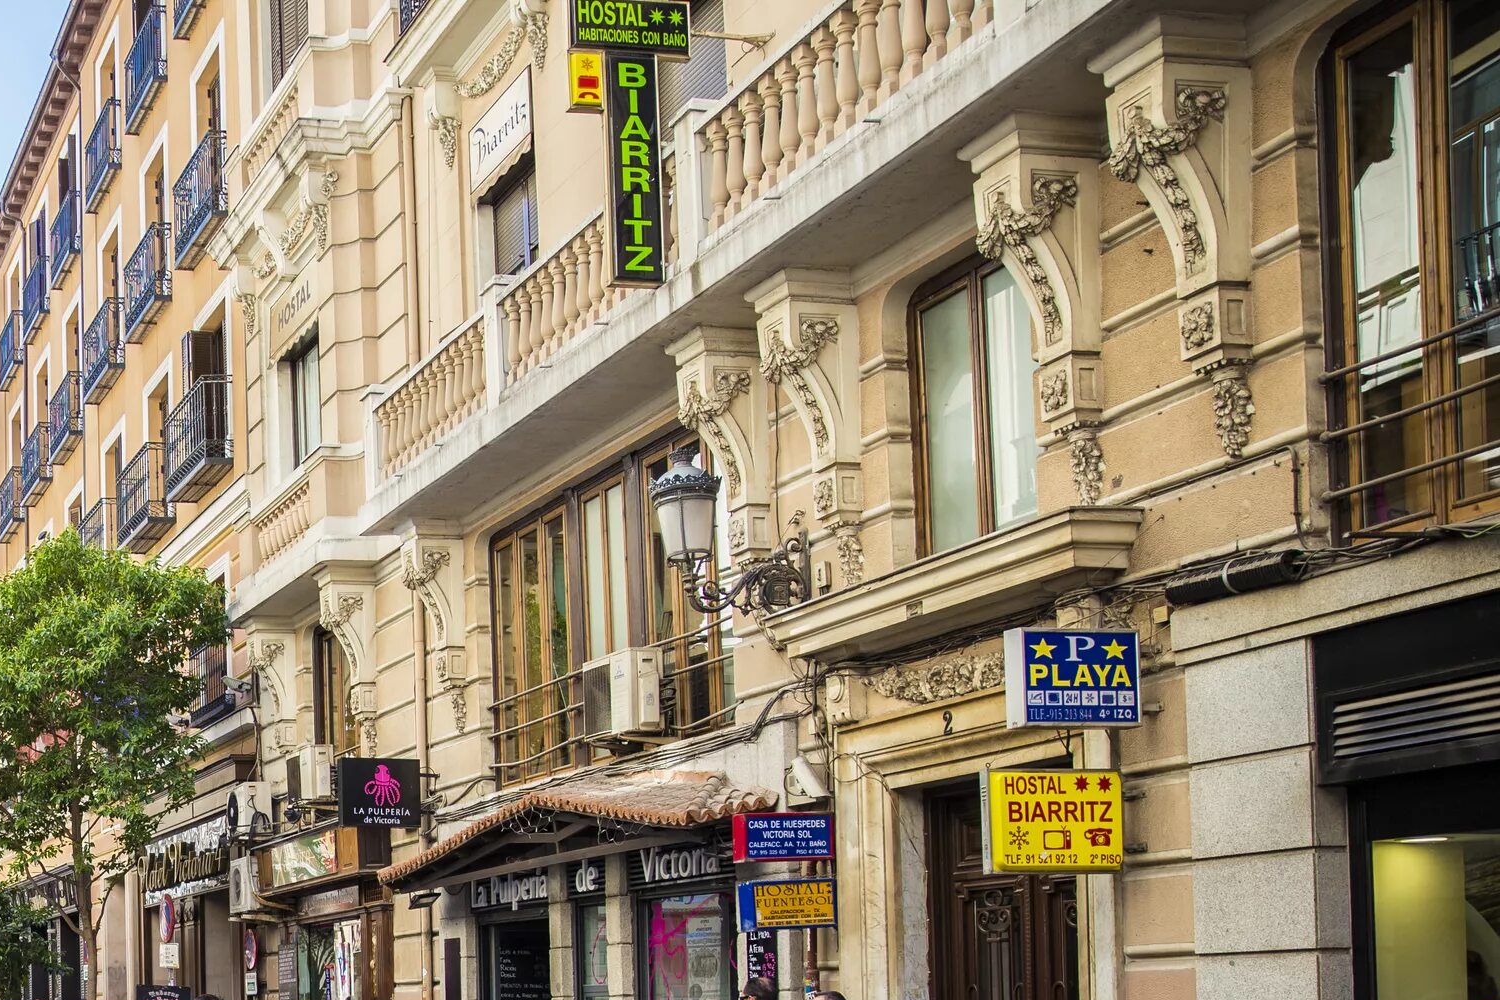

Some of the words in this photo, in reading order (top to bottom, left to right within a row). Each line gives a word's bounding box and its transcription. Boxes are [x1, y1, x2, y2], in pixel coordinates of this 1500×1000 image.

[577, 0, 648, 27] HOSTAL
[579, 28, 639, 43] HABITACIONES
[642, 31, 660, 45] CON
[663, 30, 687, 47] BAÑO
[472, 101, 528, 175] Biarritz
[616, 62, 654, 272] BIARRITZ
[277, 280, 311, 332] HOSTAL
[1064, 635, 1095, 662] P
[1029, 664, 1132, 687] PLAYA
[943, 710, 953, 736] 2
[1064, 708, 1077, 720] 213
[1079, 708, 1092, 720] 844
[1113, 709, 1136, 719] IZQ.
[1004, 776, 1066, 795] HOSTAL
[353, 807, 365, 815] LA
[368, 807, 411, 816] PULPERÍA
[363, 816, 372, 824] de
[373, 816, 400, 824] Victoria
[1008, 801, 1113, 823] BIARRITZ
[748, 820, 768, 829] CASA
[770, 820, 781, 828] DE
[783, 819, 826, 828] HUESPEDES
[762, 830, 795, 839] VICTORIA
[797, 829, 812, 838] SOL
[809, 839, 826, 847] BAÑO
[640, 847, 720, 883] Victoria
[1005, 854, 1023, 865] TLF.
[1025, 854, 1035, 864] 91
[1055, 854, 1065, 864] 92
[1068, 854, 1078, 864] 12
[1100, 854, 1122, 865] PISO
[575, 858, 598, 892] de
[470, 879, 488, 908] La
[755, 883, 824, 897] HOSTAL
[756, 895, 834, 908] FUENTESOL
